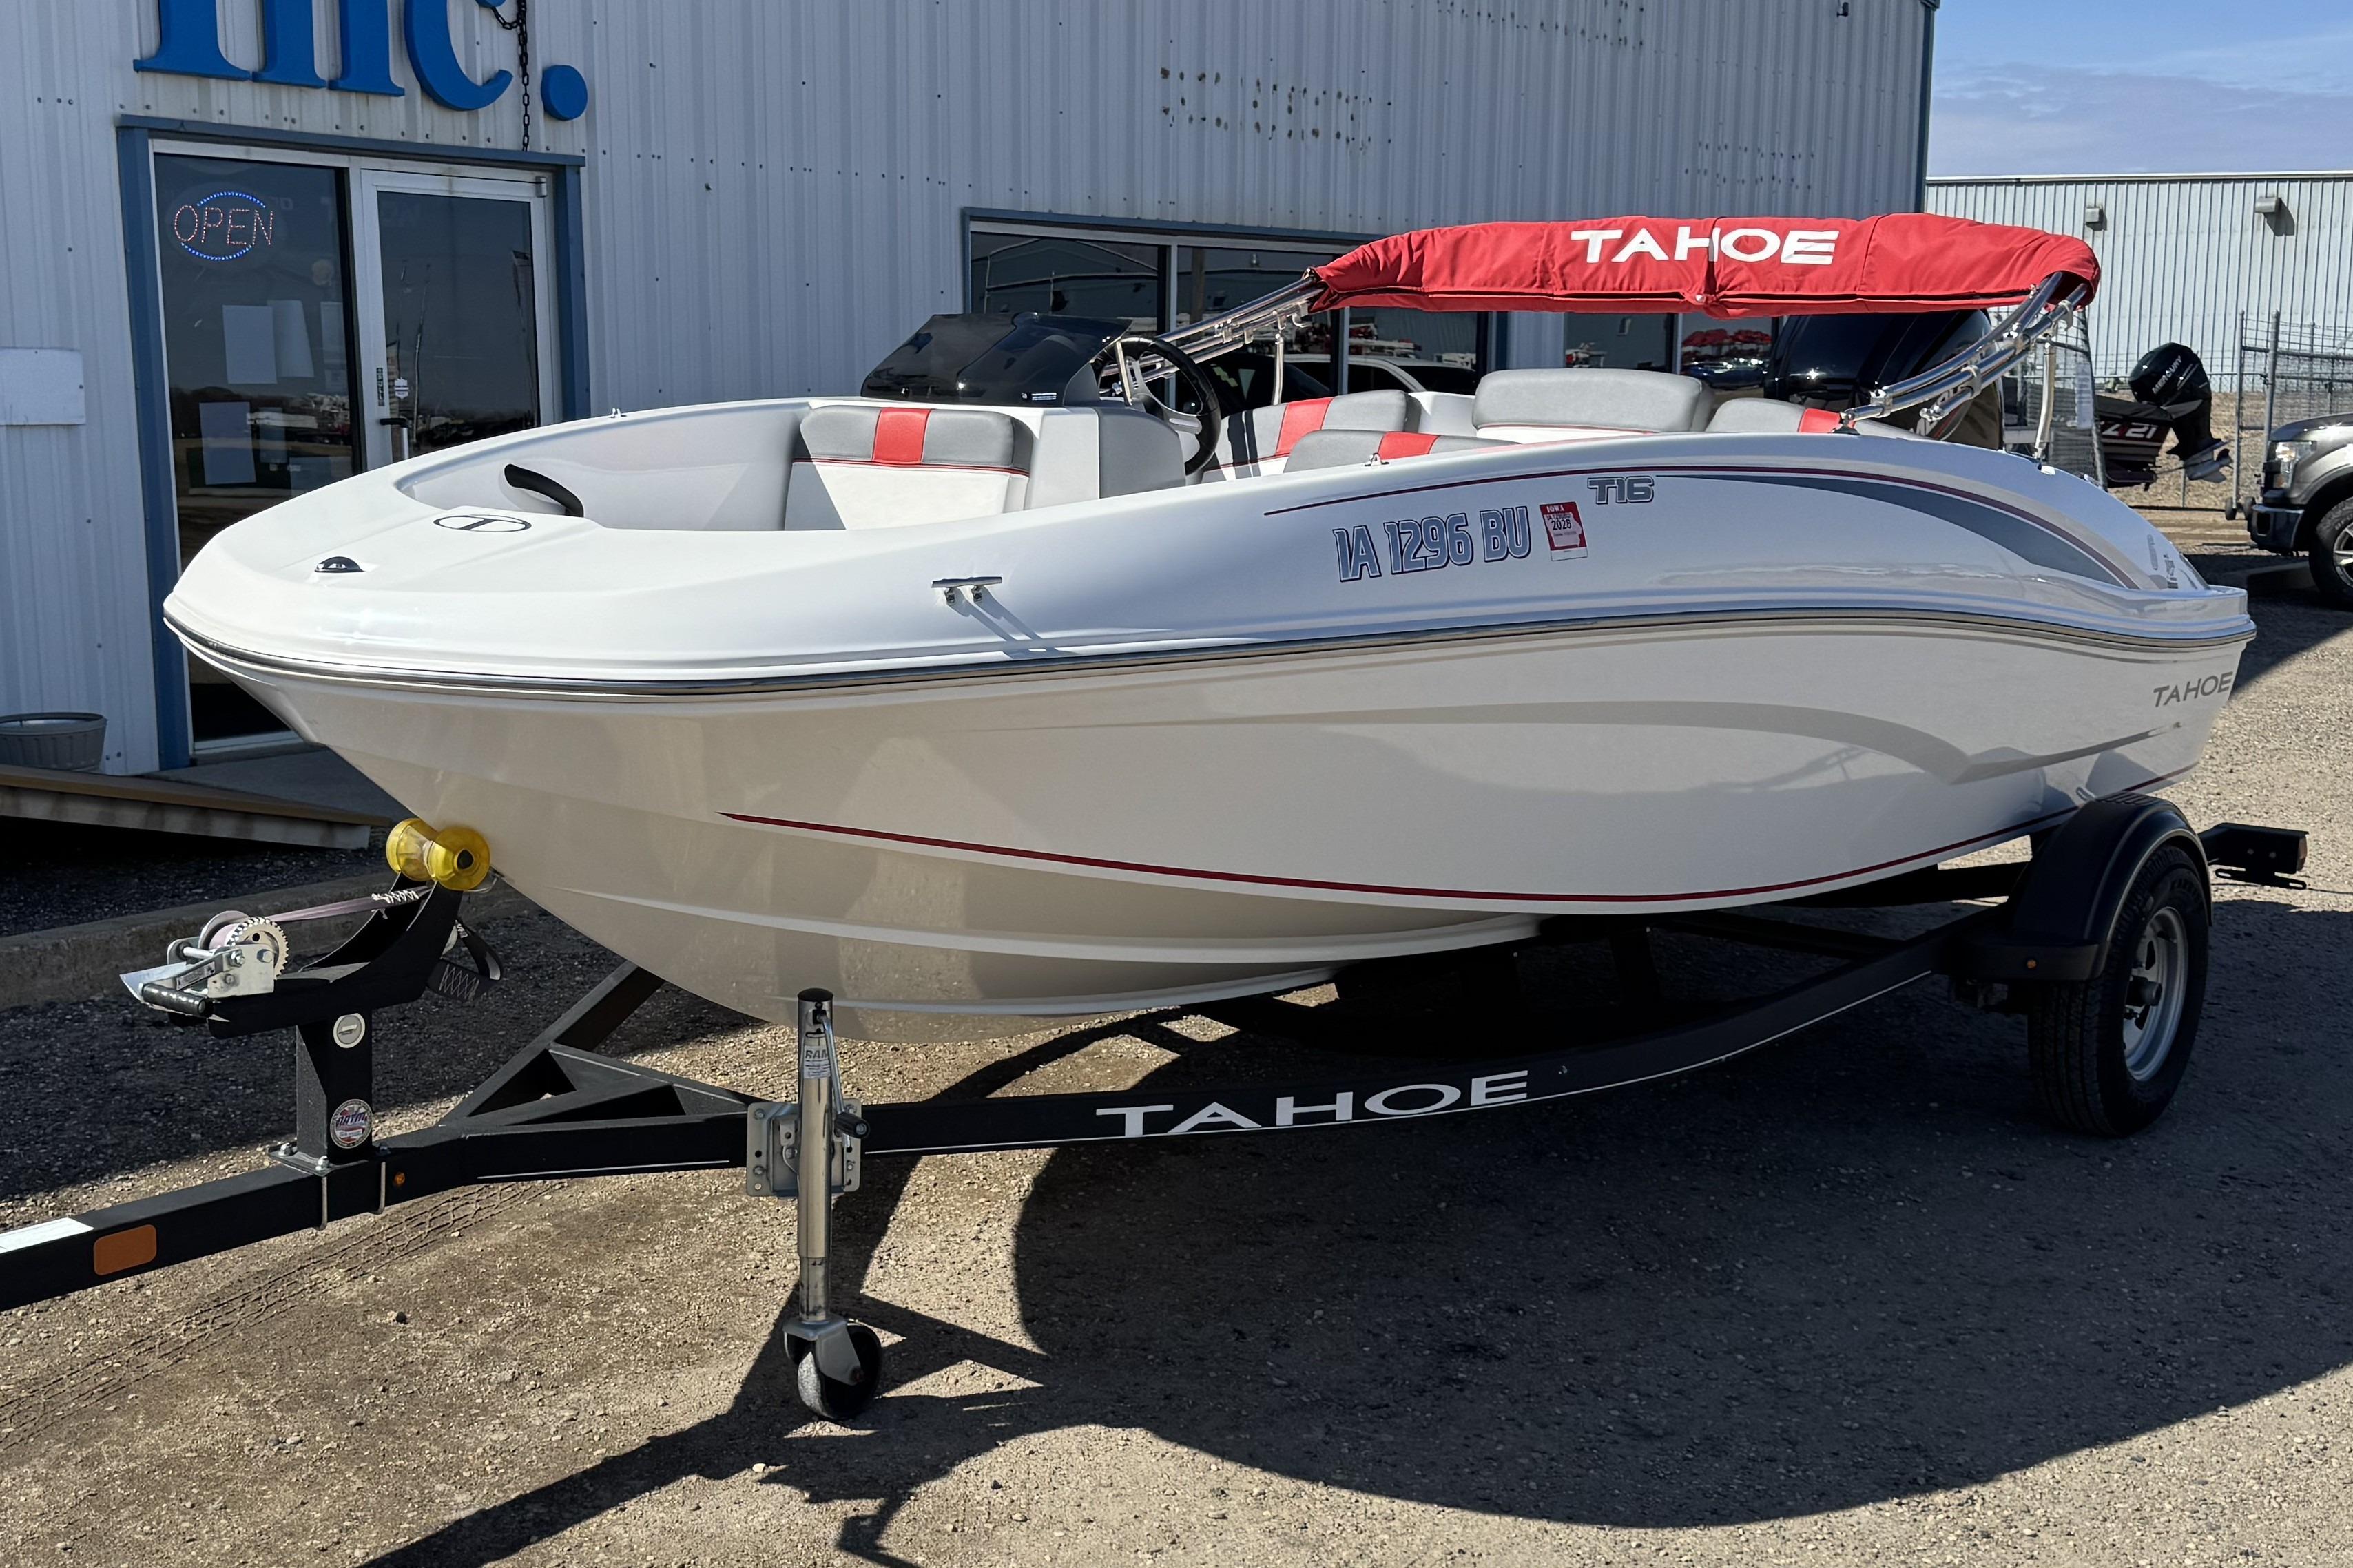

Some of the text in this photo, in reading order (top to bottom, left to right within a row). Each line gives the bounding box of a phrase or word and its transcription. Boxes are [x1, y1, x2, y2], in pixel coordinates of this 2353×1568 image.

[174, 205, 273, 245] OPEN
[1570, 226, 1840, 264] TAHOE
[2152, 355, 2182, 395] MERCURY
[1546, 504, 1565, 514] IOWA
[1587, 476, 1655, 504] T16
[1333, 505, 1531, 582] IA 1296 BU
[2153, 671, 2233, 707] TAHOE
[1096, 1069, 1528, 1138] TAHOE
